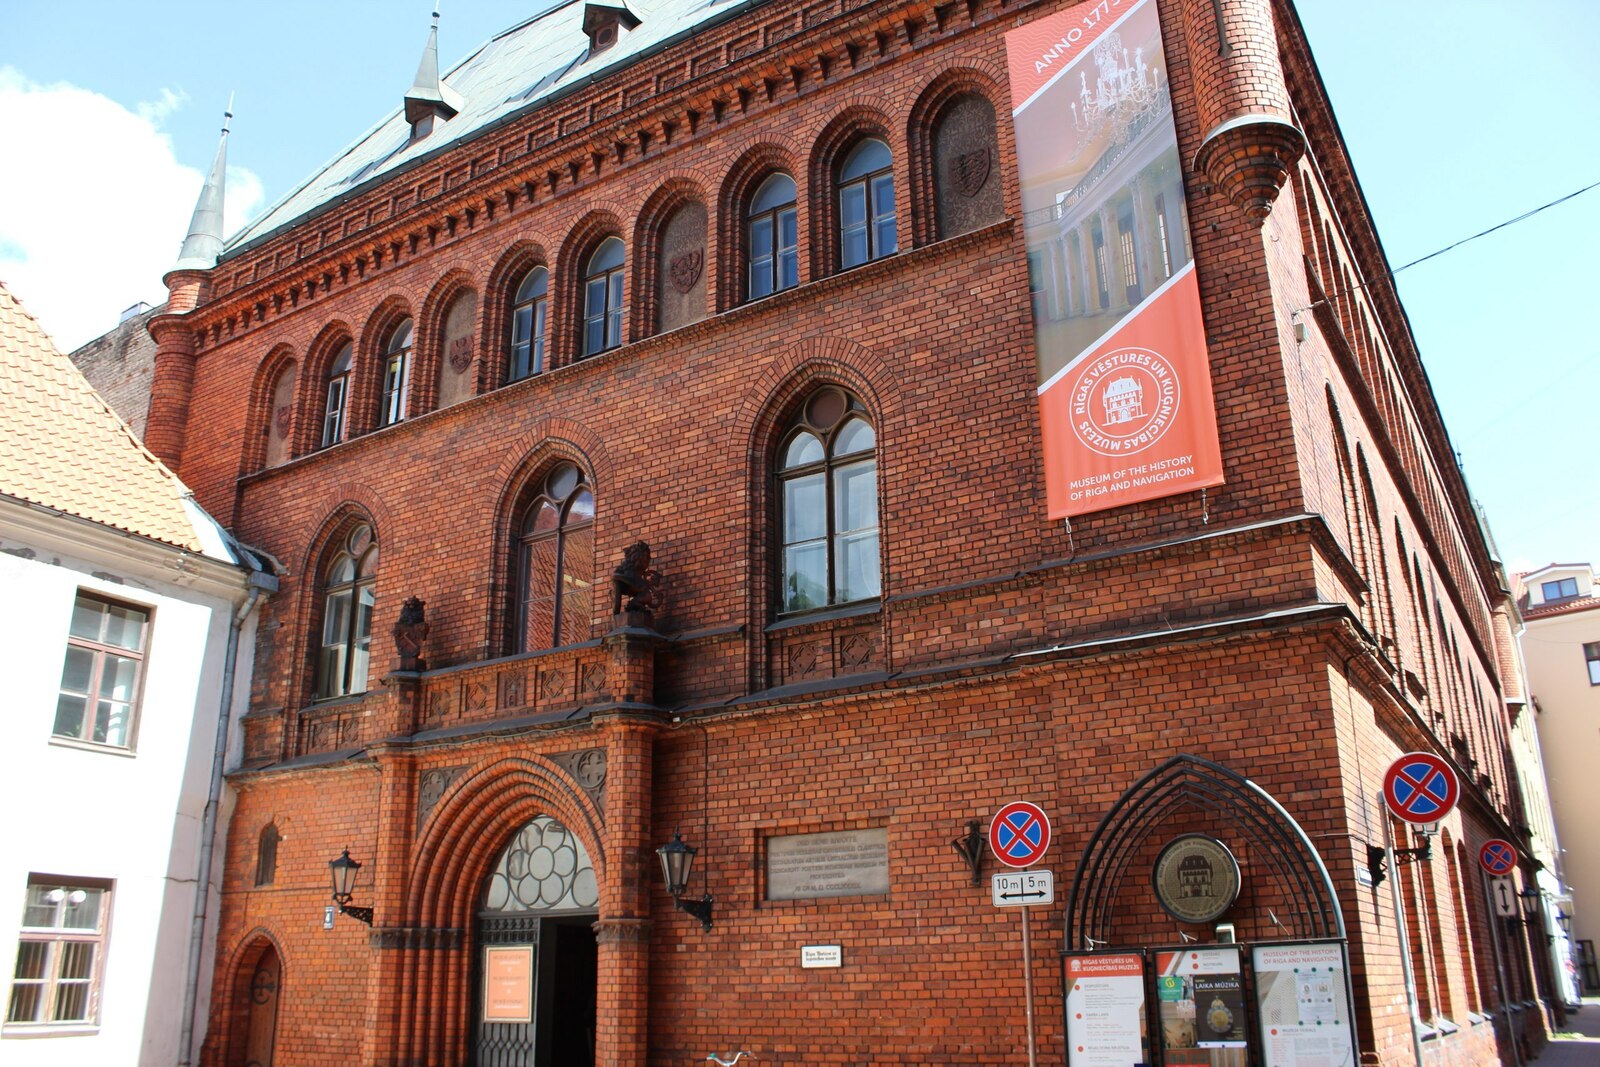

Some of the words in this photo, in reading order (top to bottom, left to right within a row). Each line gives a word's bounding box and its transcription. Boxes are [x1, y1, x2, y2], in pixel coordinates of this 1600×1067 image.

[1034, 28, 1082, 73] ANNO
[1090, 353, 1151, 378] VĒSTURES
[1151, 361, 1167, 378] UN
[1074, 377, 1094, 415] RĪGAS
[1124, 378, 1174, 449] KUĢNIECĪBAS
[1079, 421, 1121, 450] MUZEJS
[1070, 473, 1111, 490] MUSEUM
[1113, 470, 1126, 480] OF
[1128, 464, 1148, 476] THE
[1150, 455, 1193, 472] HISTORY
[1070, 491, 1083, 501] OF
[1085, 486, 1108, 498] RIGA
[1110, 481, 1131, 492] AND
[1133, 467, 1195, 487] NAVIGATION
[997, 879, 1008, 889] 10
[1029, 877, 1035, 887] 5
